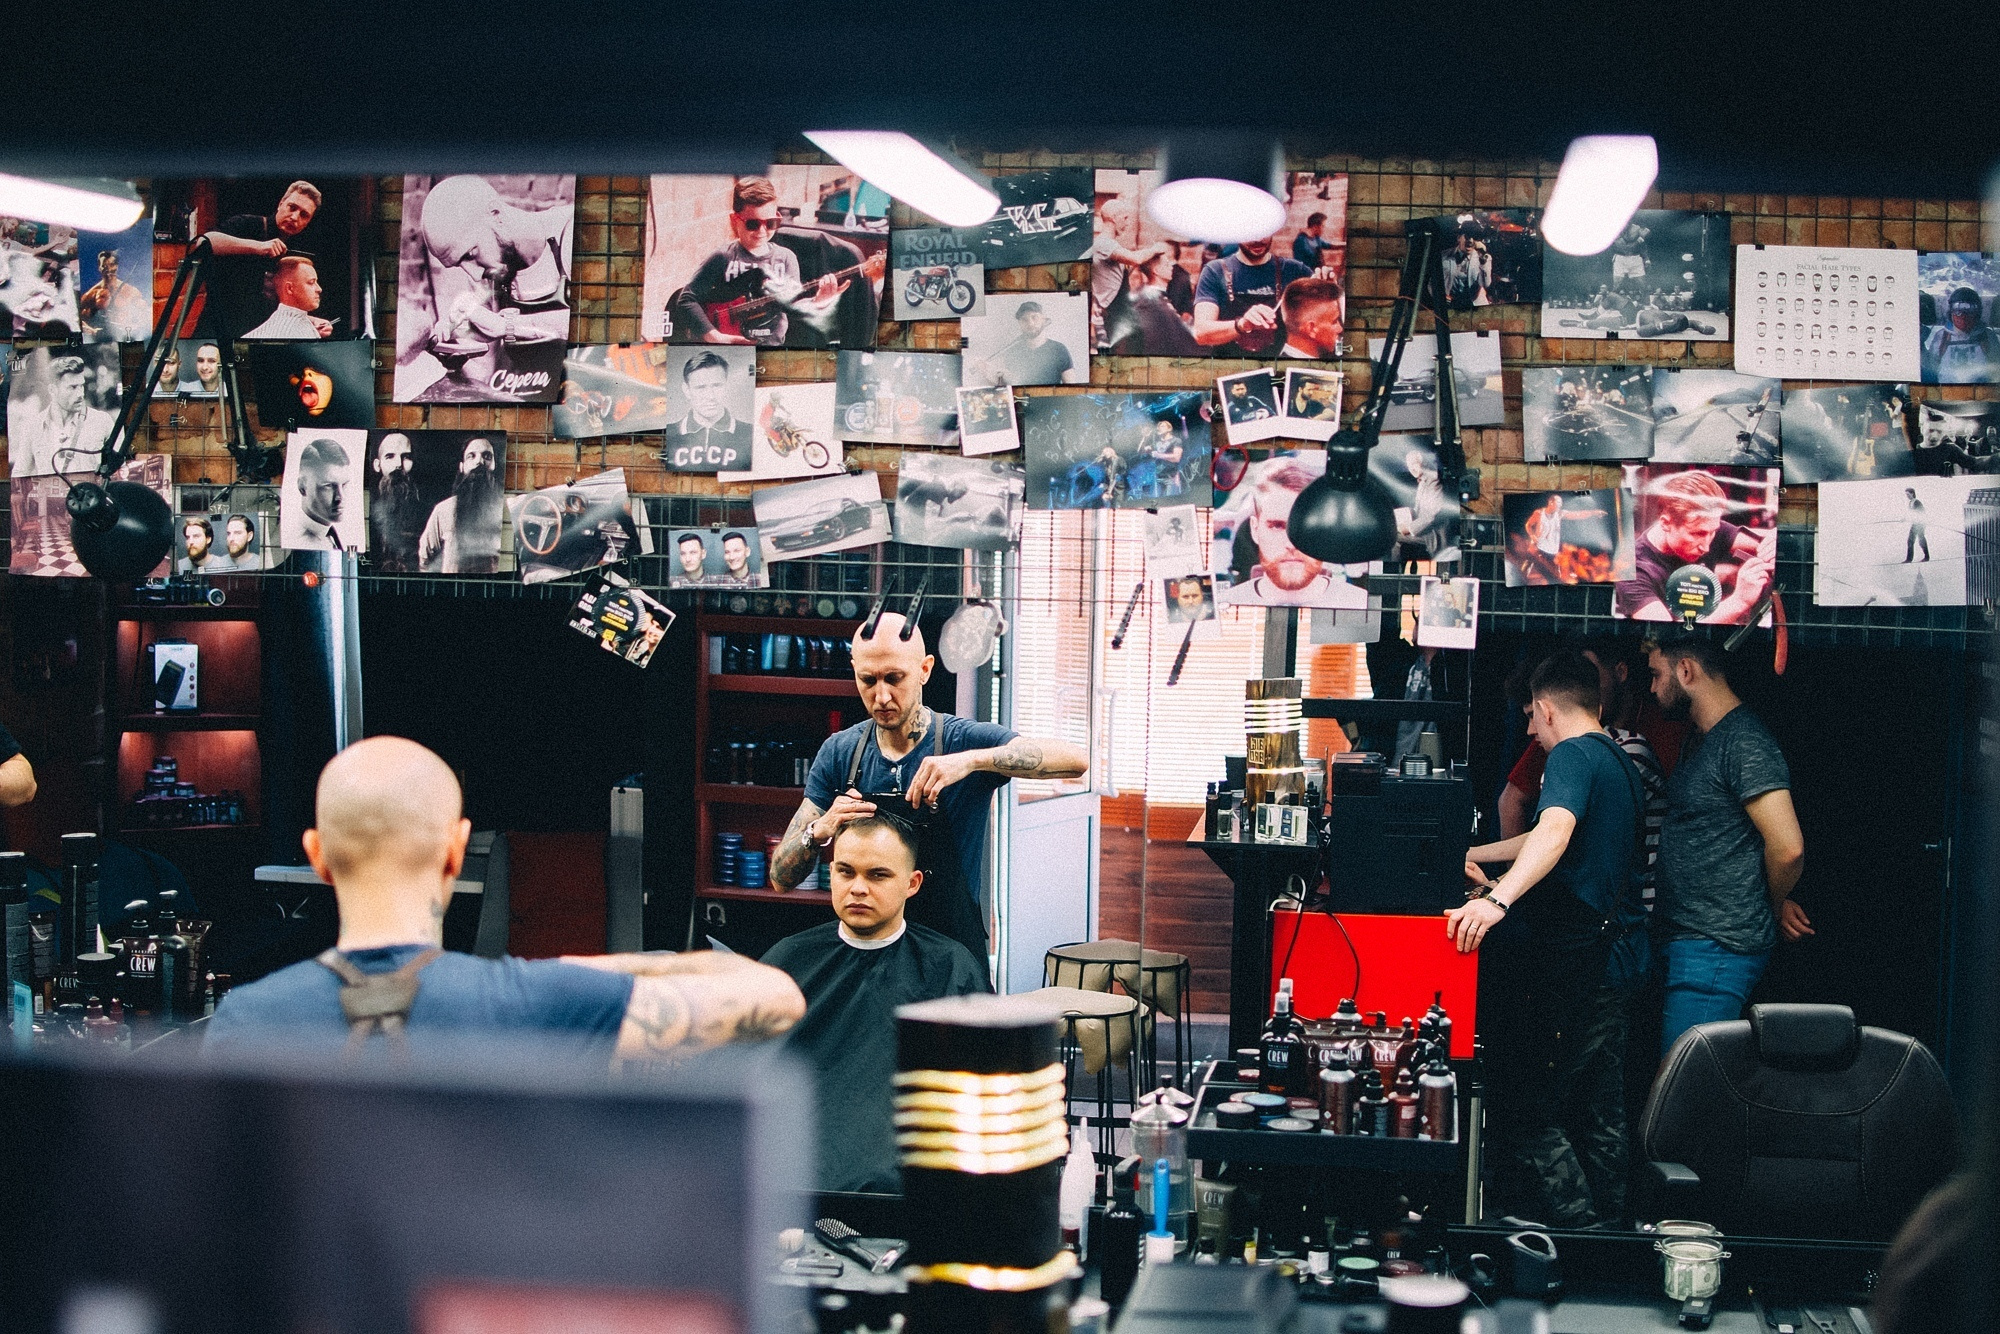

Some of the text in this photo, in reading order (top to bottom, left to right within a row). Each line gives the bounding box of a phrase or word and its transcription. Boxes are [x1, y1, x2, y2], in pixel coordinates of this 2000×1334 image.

[904, 233, 968, 253] ROYAL
[725, 259, 786, 285] HEO
[130, 956, 156, 972] CREW
[1267, 1050, 1289, 1063] CREW
[1374, 1050, 1397, 1063] CREW
[1203, 1191, 1225, 1205] CREW
